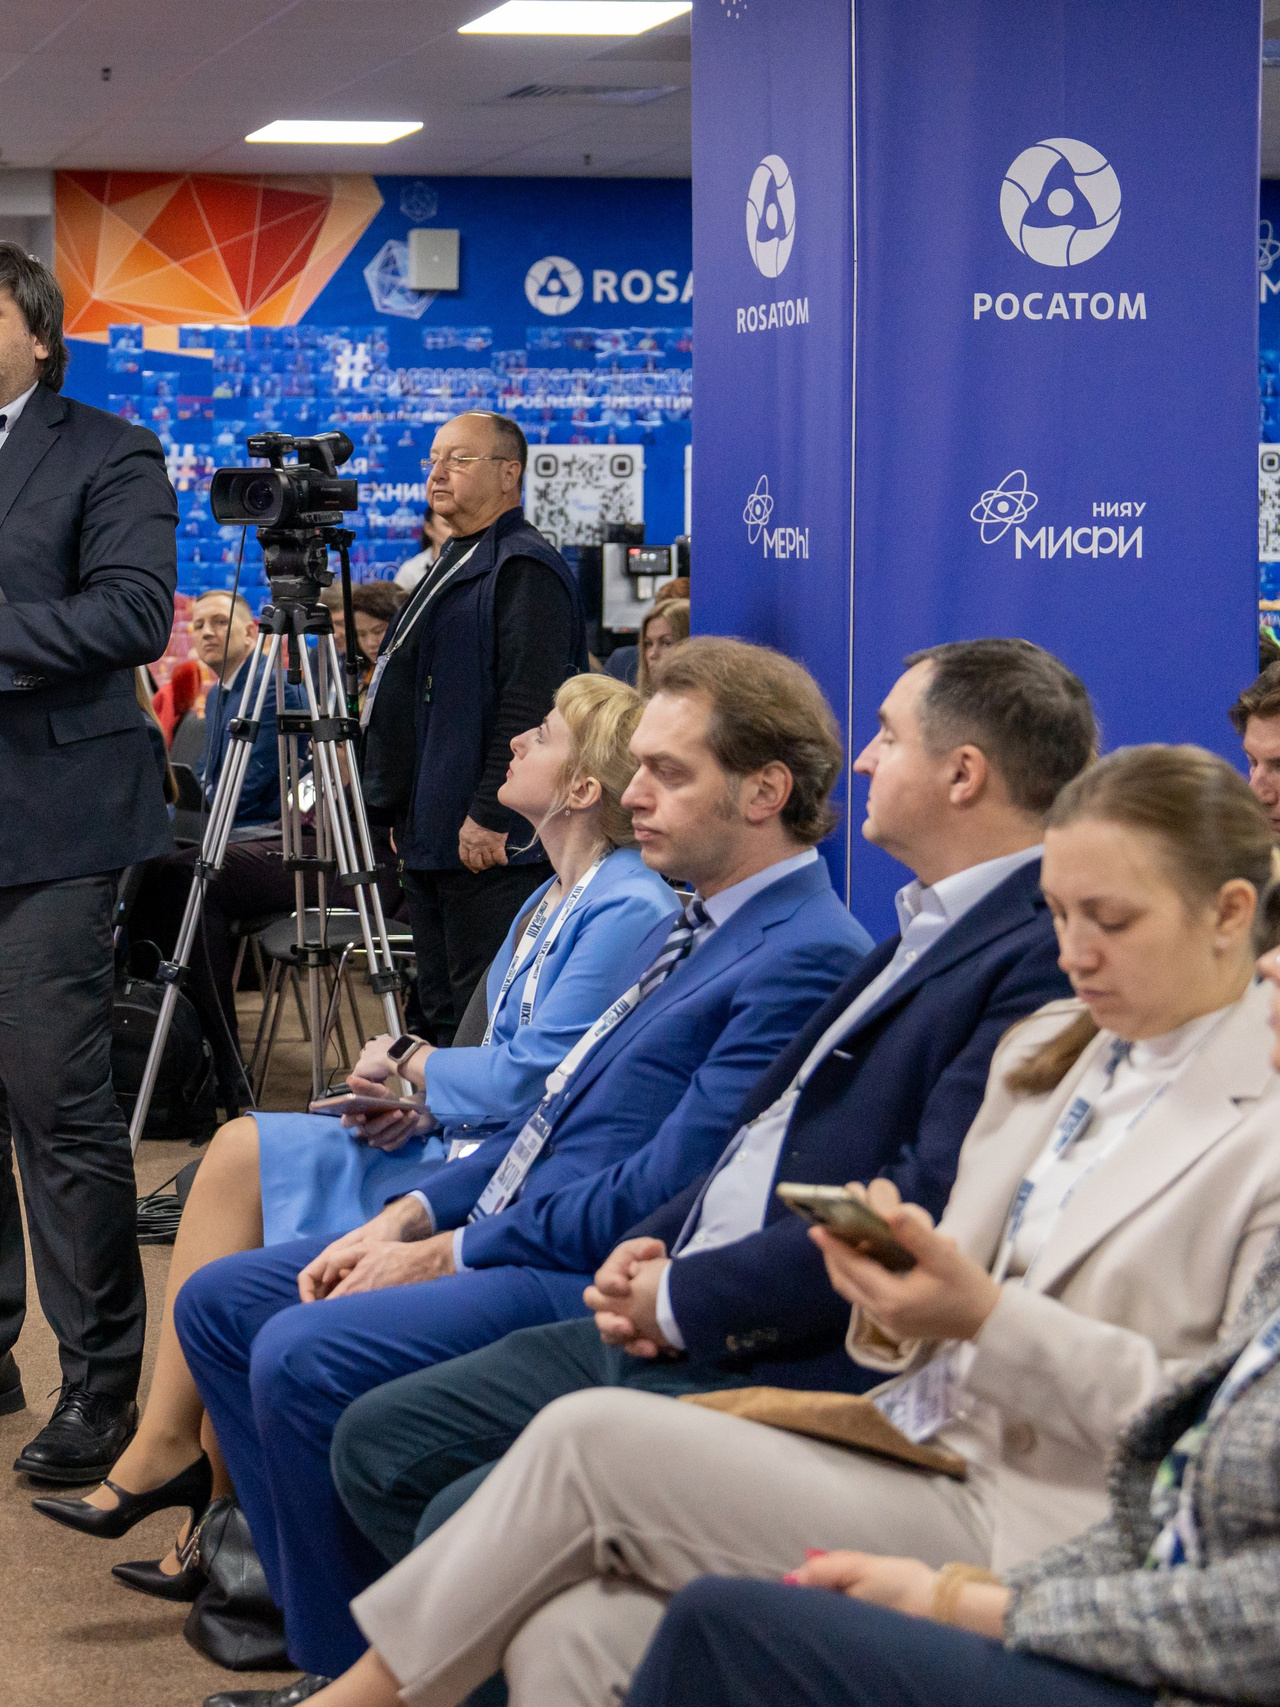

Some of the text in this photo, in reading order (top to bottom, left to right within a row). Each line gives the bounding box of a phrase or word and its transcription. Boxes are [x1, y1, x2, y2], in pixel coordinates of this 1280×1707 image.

[737, 297, 809, 334] ROSATOM
[973, 292, 1147, 321] РОСАТОМ
[1092, 502, 1147, 518] НИЯУ
[1015, 526, 1143, 559] МИФИ
